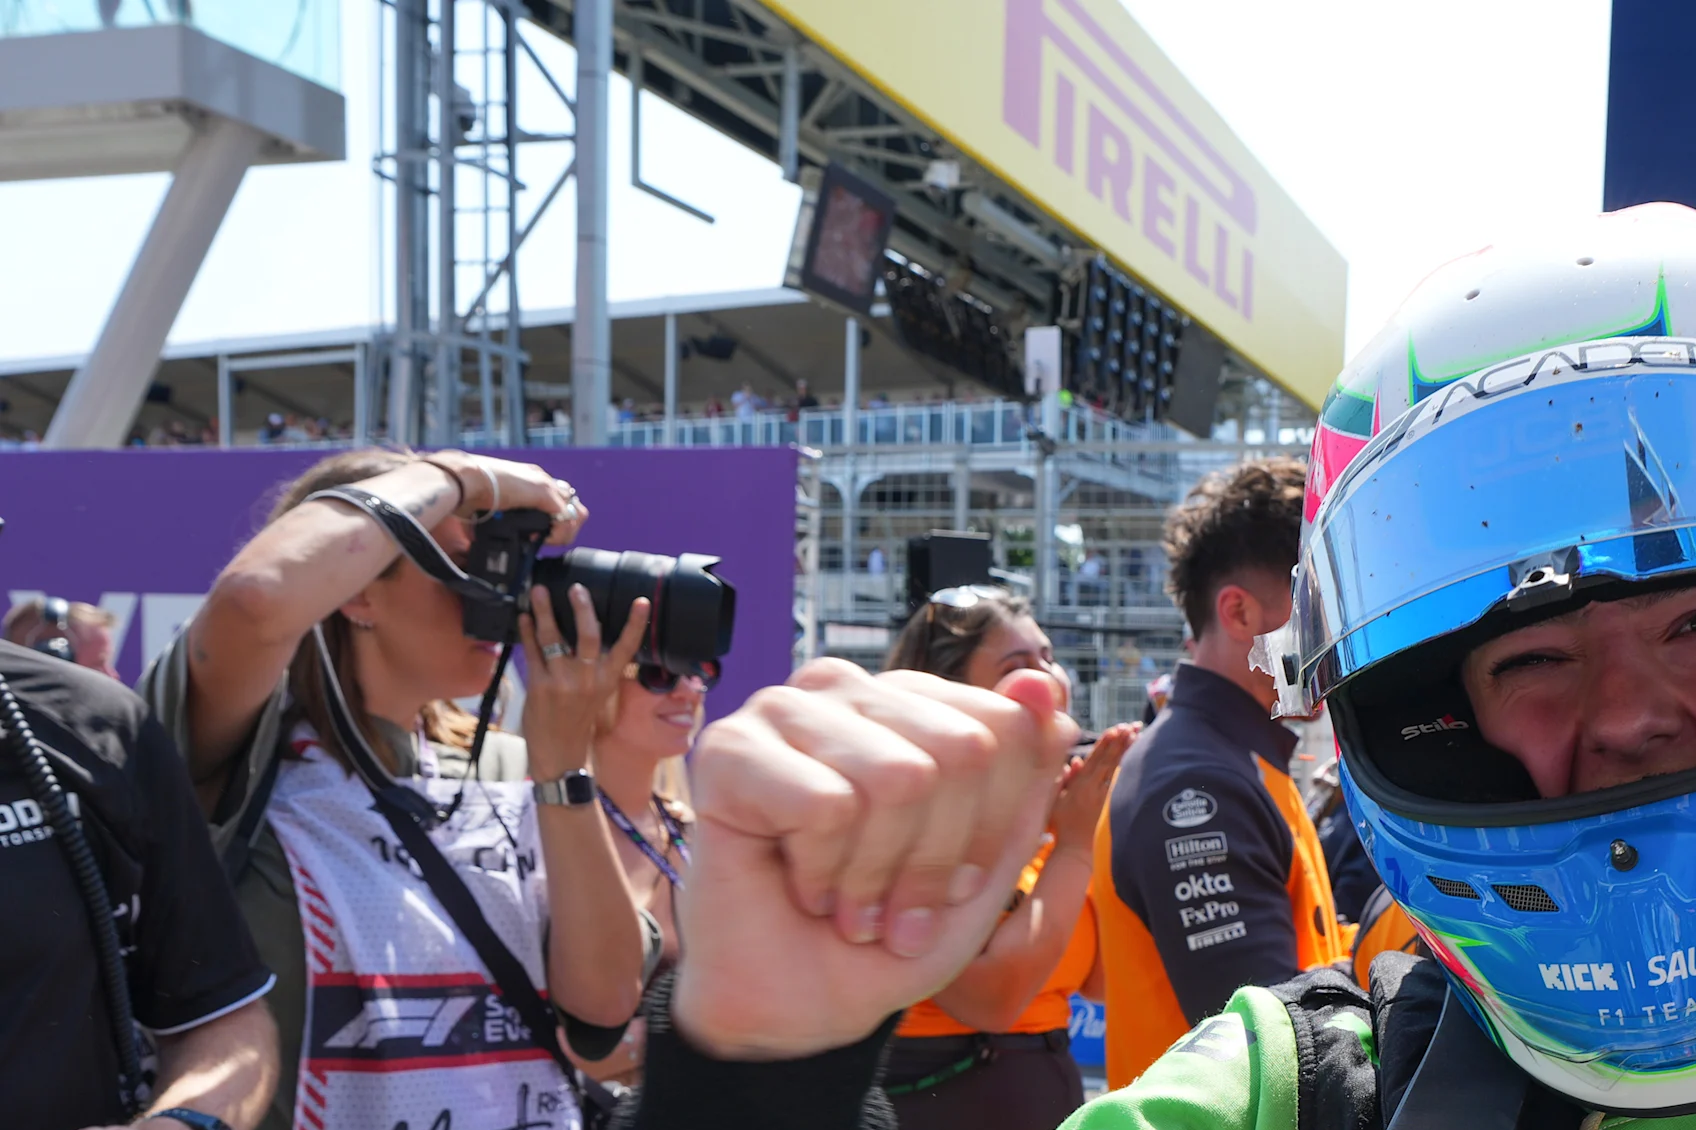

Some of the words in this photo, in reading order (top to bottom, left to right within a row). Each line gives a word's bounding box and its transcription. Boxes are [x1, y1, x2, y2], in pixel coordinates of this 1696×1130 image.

[1001, 0, 1258, 324] PIRELLI
[1170, 838, 1223, 857] Hilton
[1174, 872, 1234, 901] okta
[1179, 901, 1239, 928] FxPro
[1187, 921, 1247, 951] PIRELLI
[1538, 963, 1618, 990] KICK
[1598, 1008, 1625, 1026] F1
